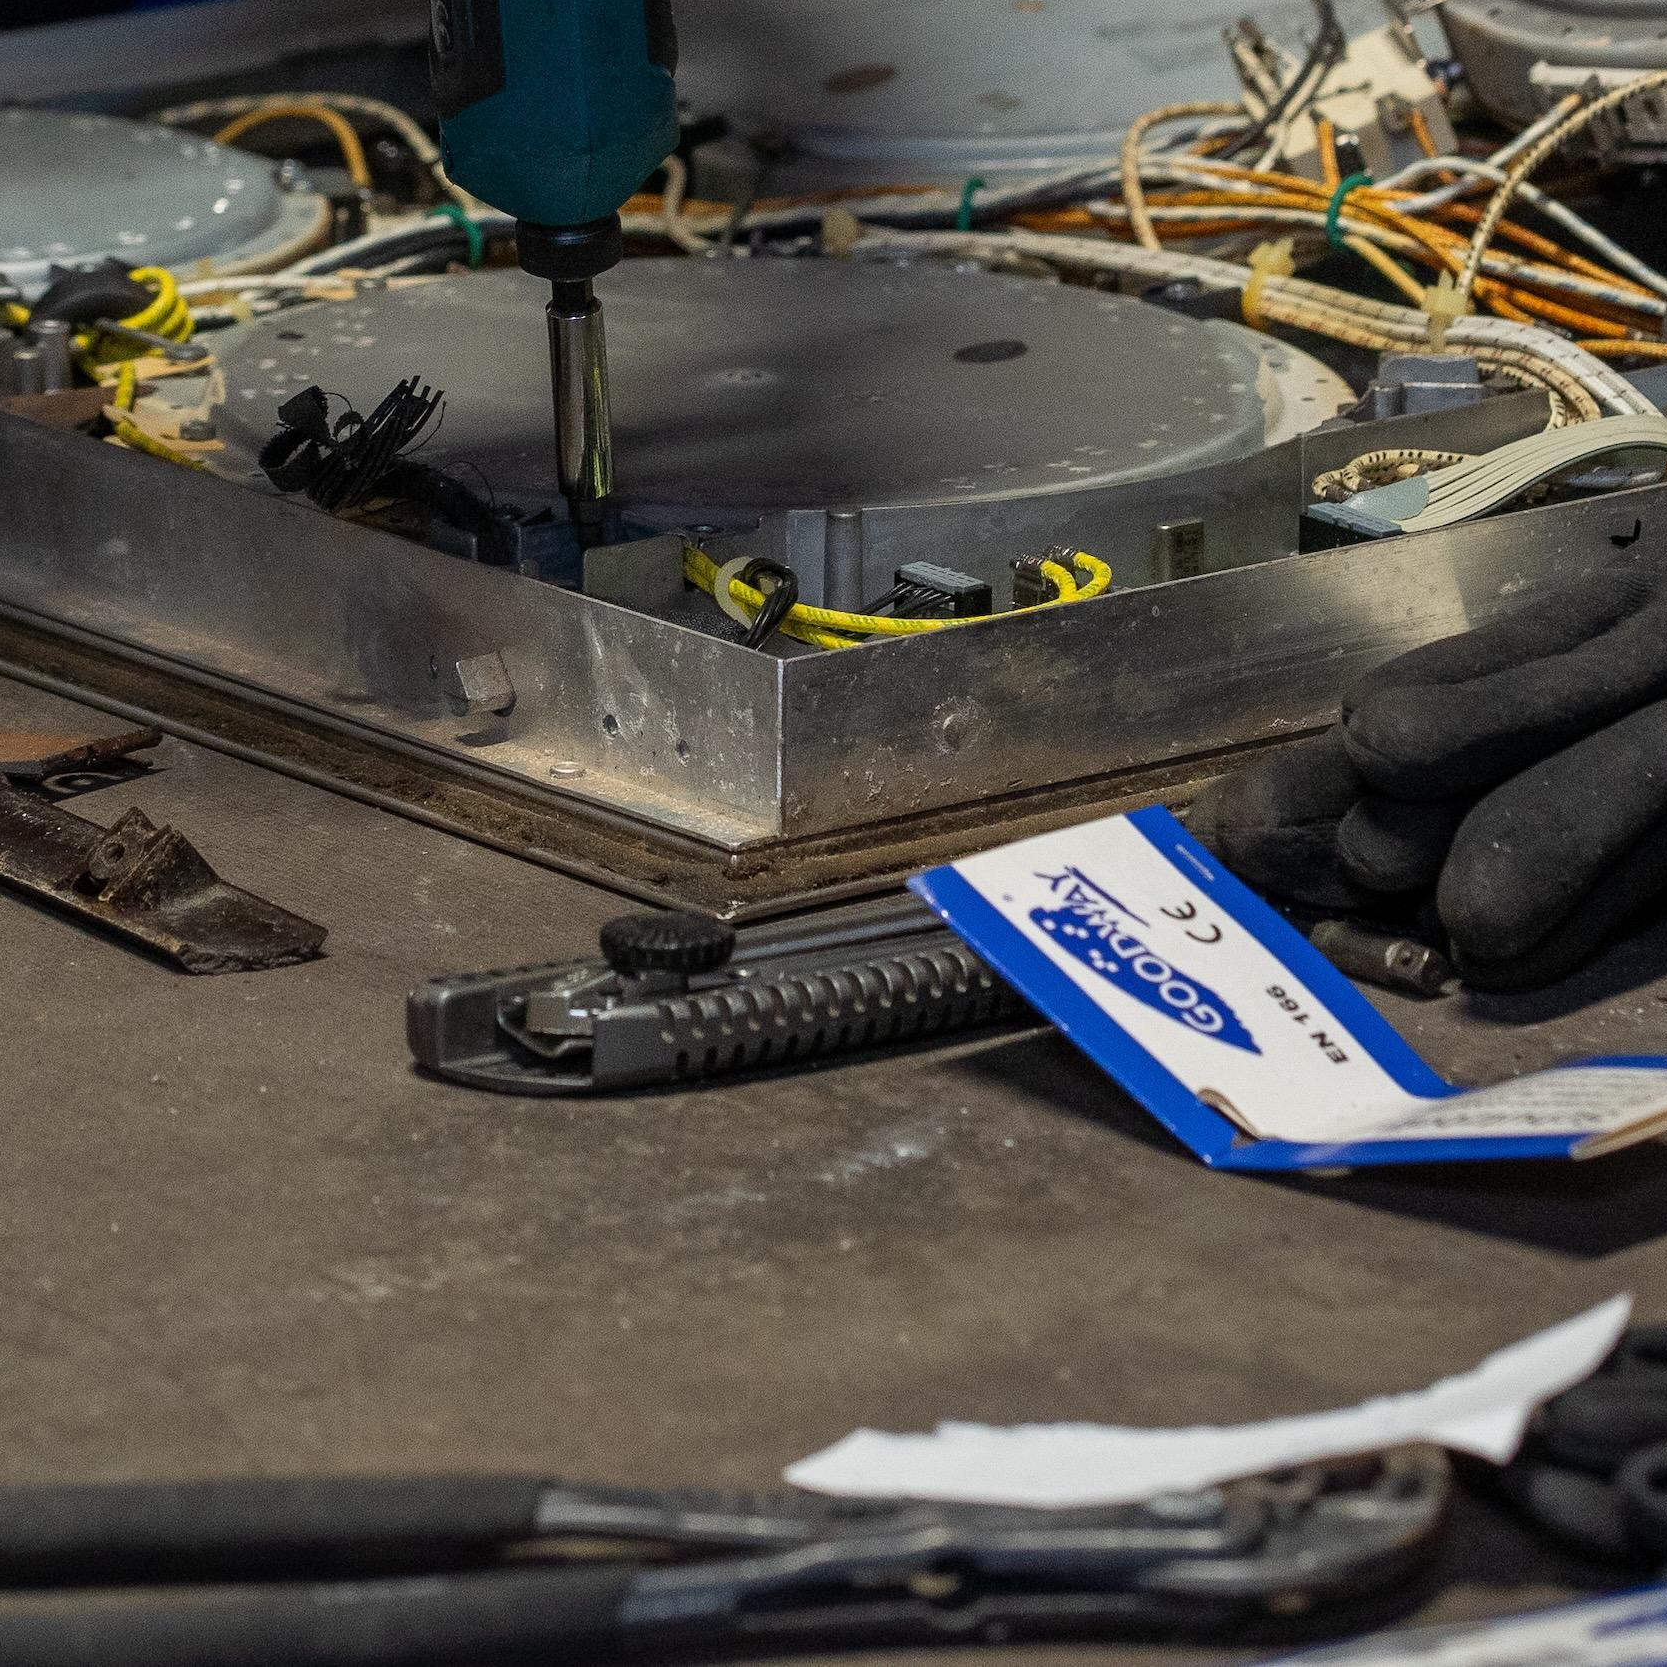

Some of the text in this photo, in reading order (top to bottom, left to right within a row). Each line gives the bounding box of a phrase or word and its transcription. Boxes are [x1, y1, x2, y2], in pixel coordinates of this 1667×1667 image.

[1034, 864, 1224, 1034] GOODWAY
[1160, 901, 1223, 944] CE
[1265, 984, 1349, 1065] EN 166
